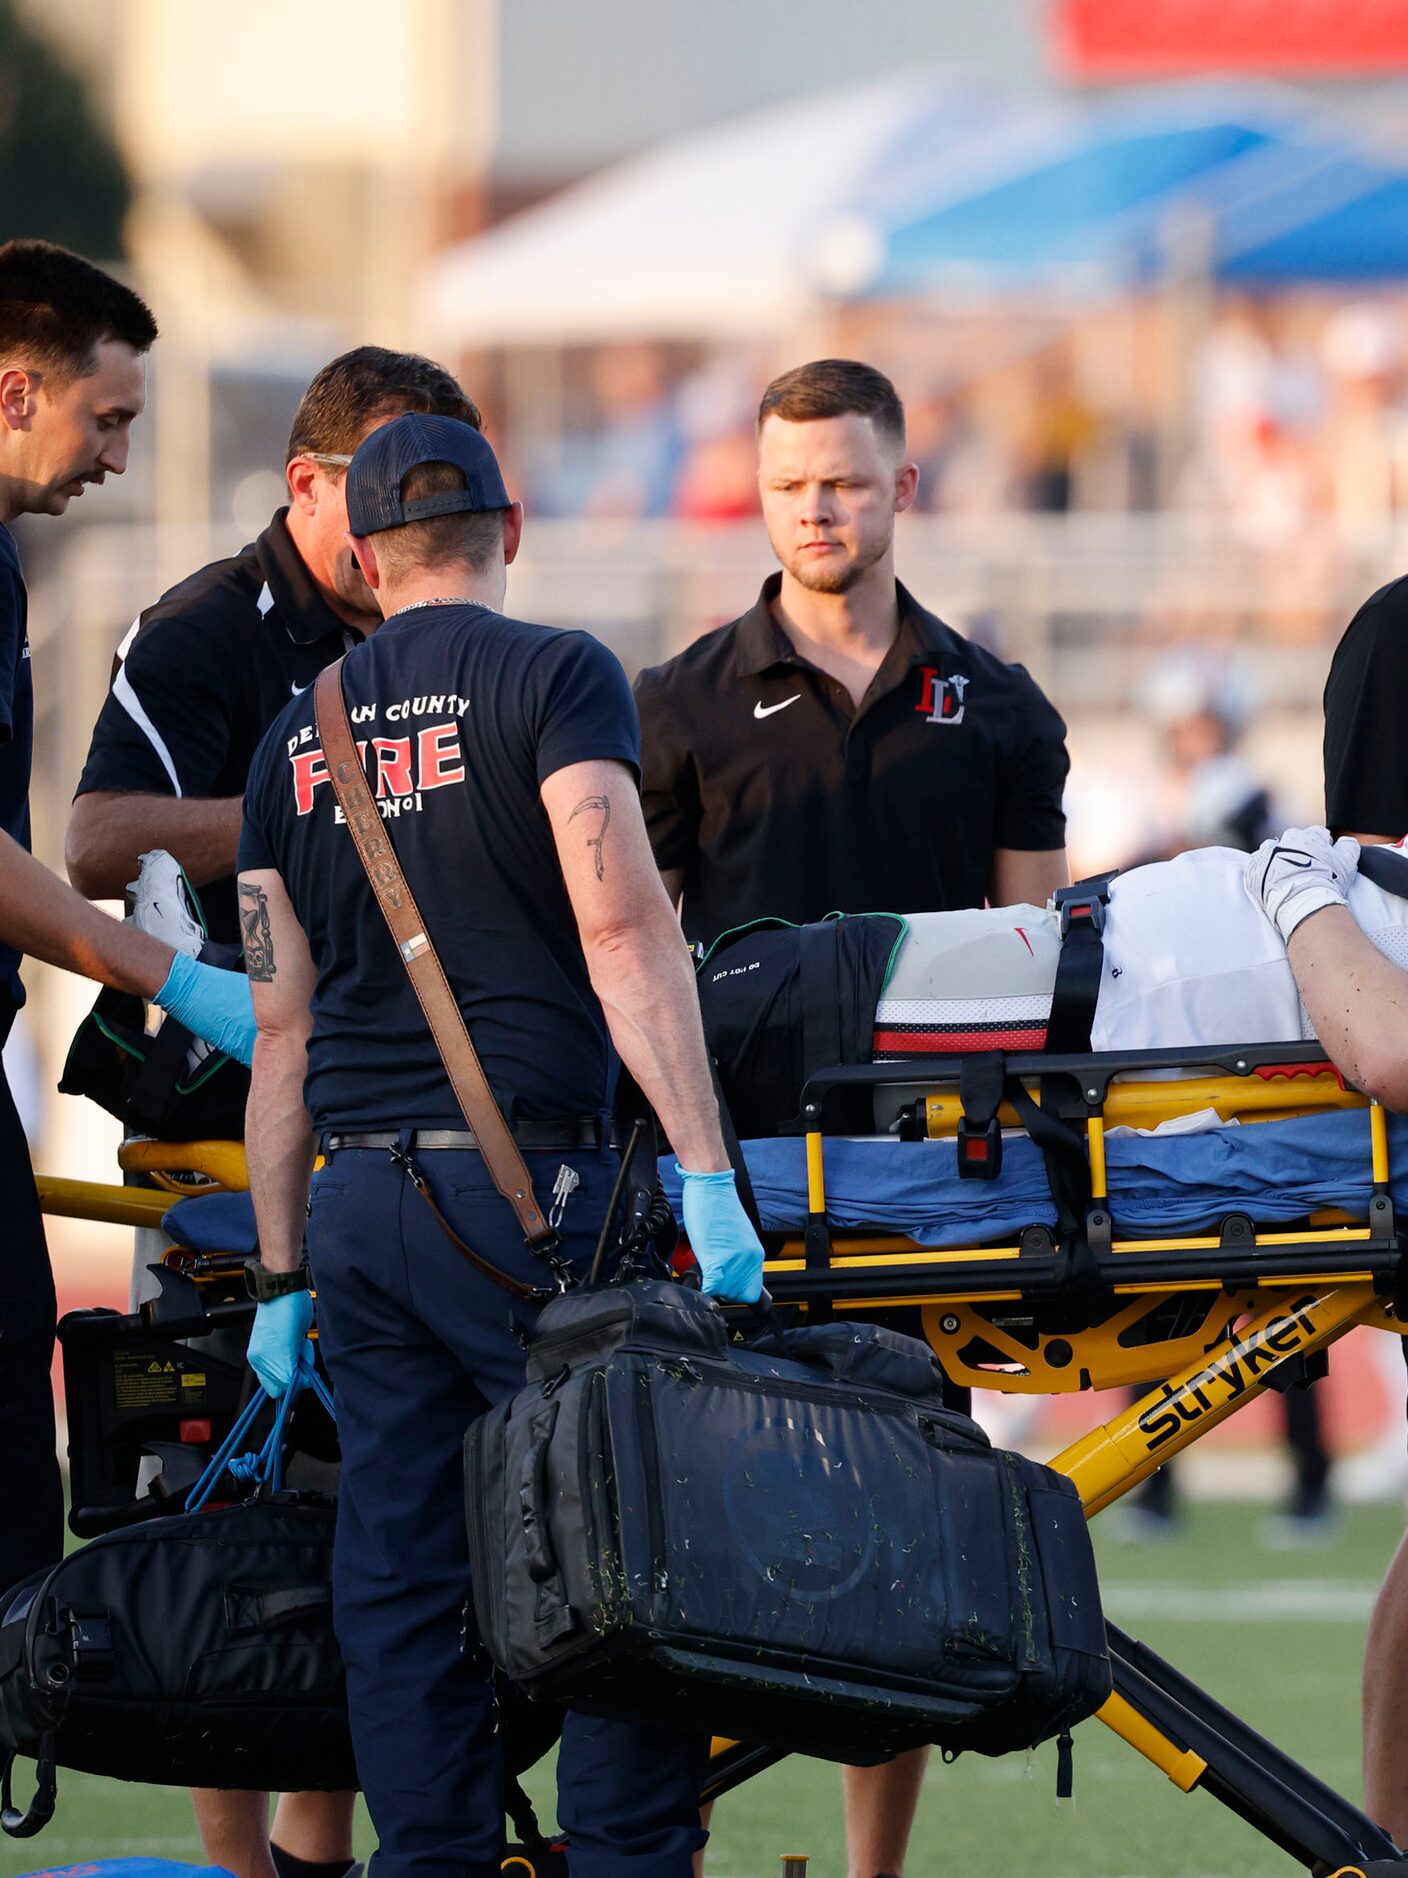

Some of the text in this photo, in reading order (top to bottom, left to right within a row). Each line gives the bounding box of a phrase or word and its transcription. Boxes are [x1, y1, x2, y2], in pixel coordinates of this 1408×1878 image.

[385, 694, 471, 722] COUNTY
[712, 961, 760, 982] DO NOT CUT
[1138, 1295, 1321, 1451] stryker
